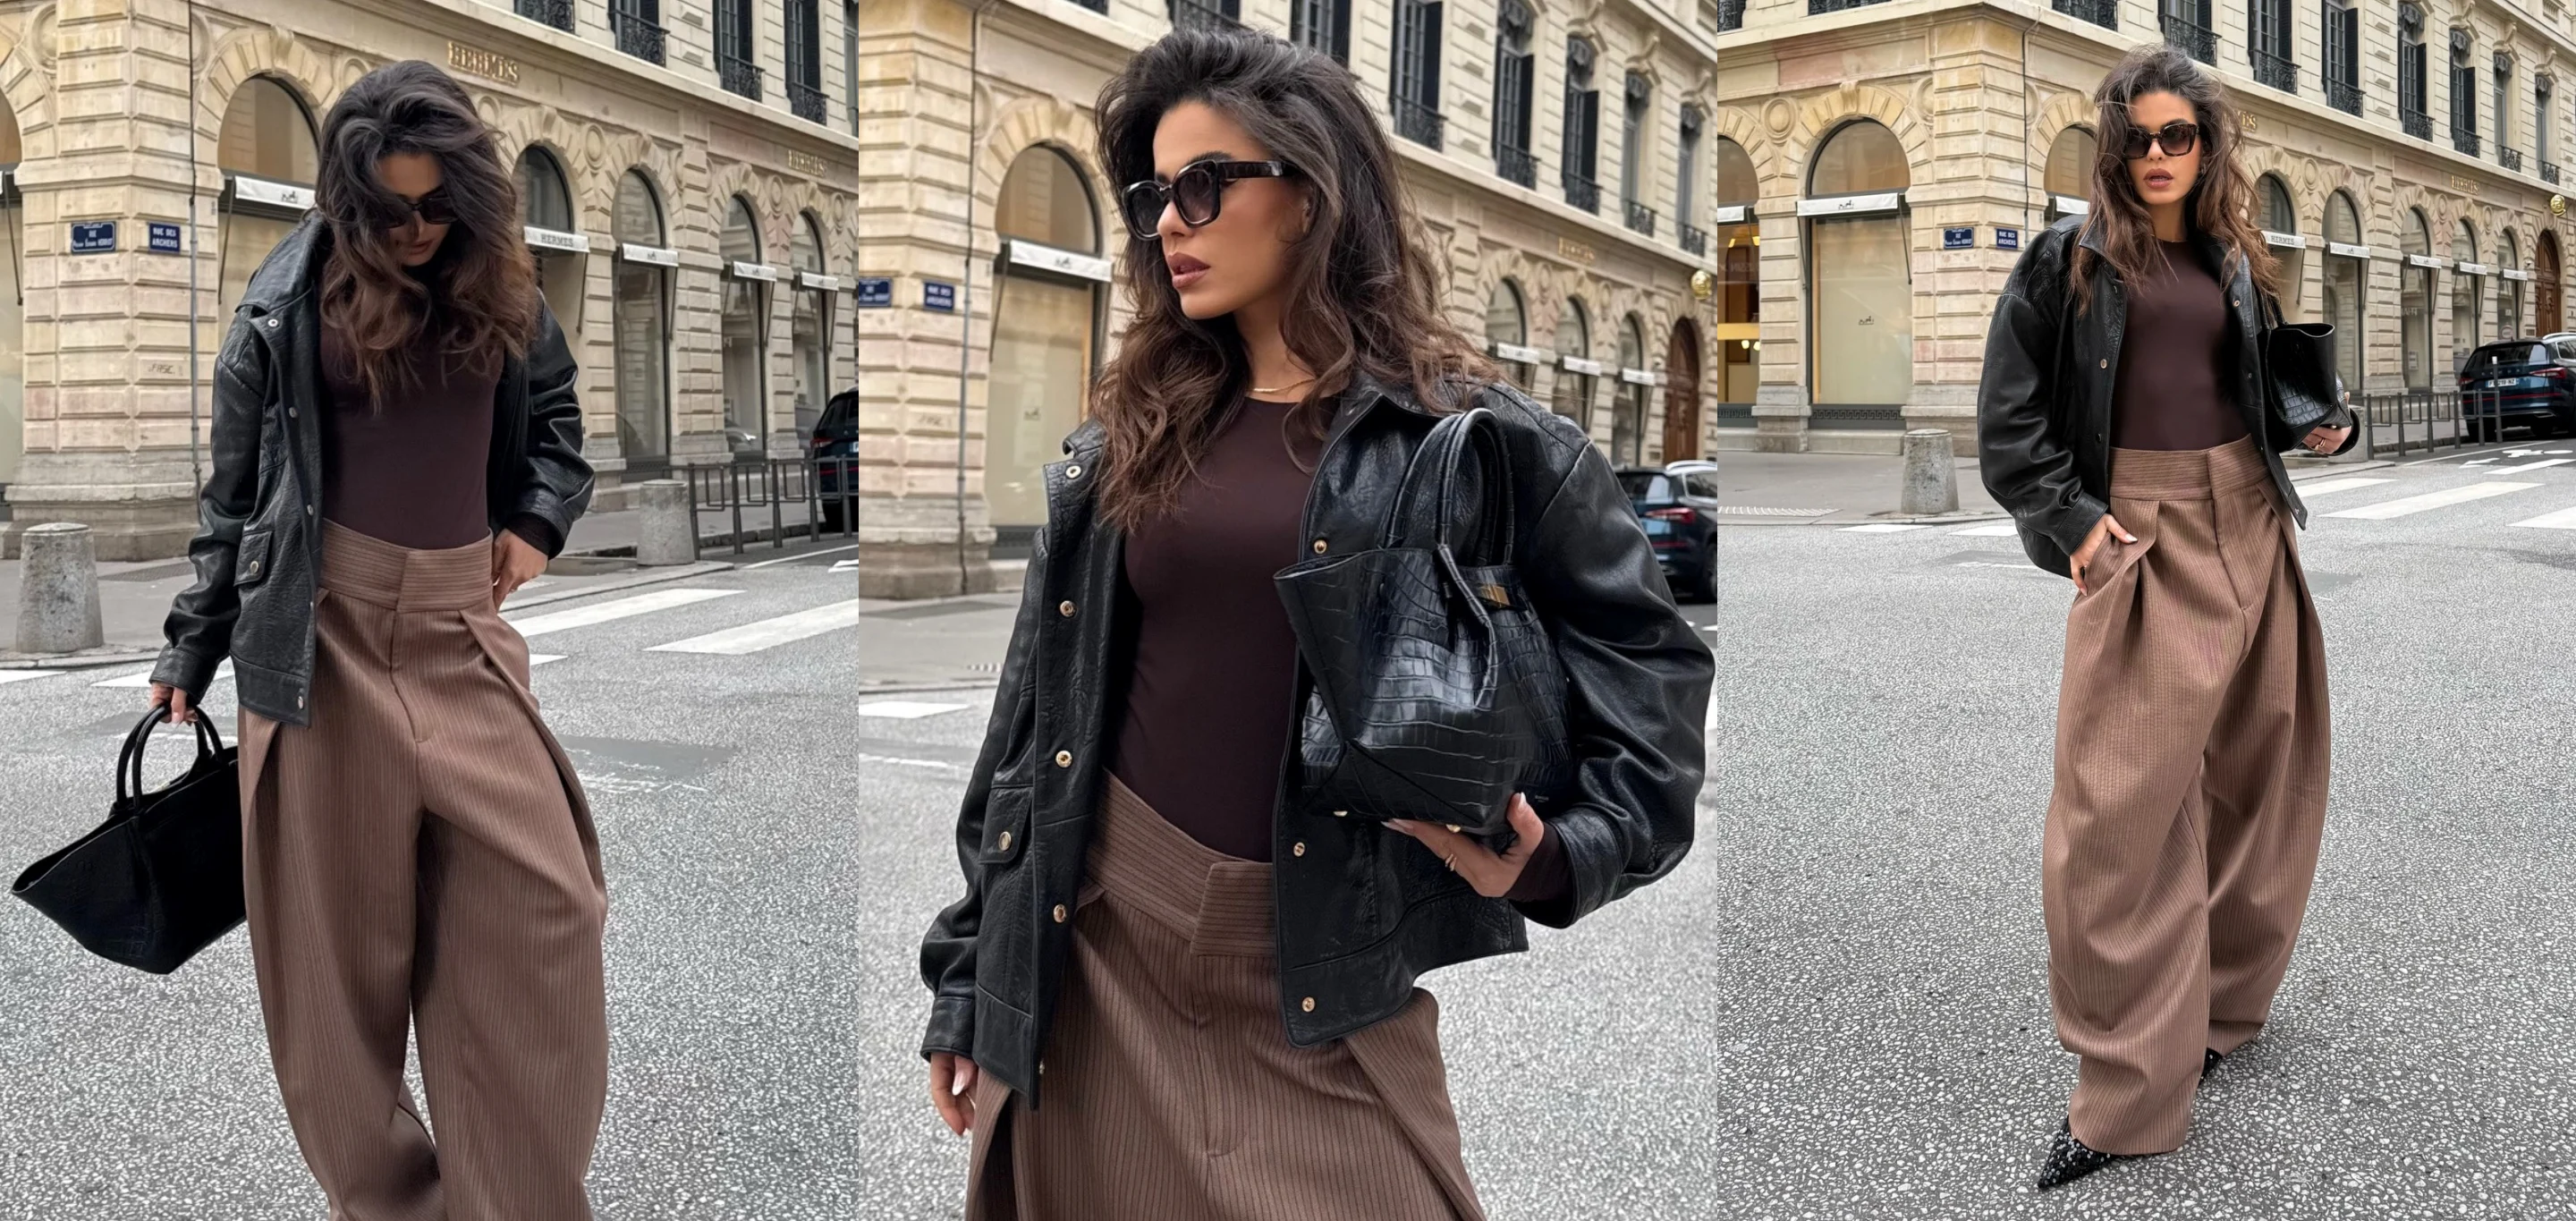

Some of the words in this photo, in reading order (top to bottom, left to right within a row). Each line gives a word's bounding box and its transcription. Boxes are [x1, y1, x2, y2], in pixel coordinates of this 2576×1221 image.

[153, 227, 164, 236] RUE
[165, 228, 176, 237] DES
[152, 238, 178, 248] ARCHERS
